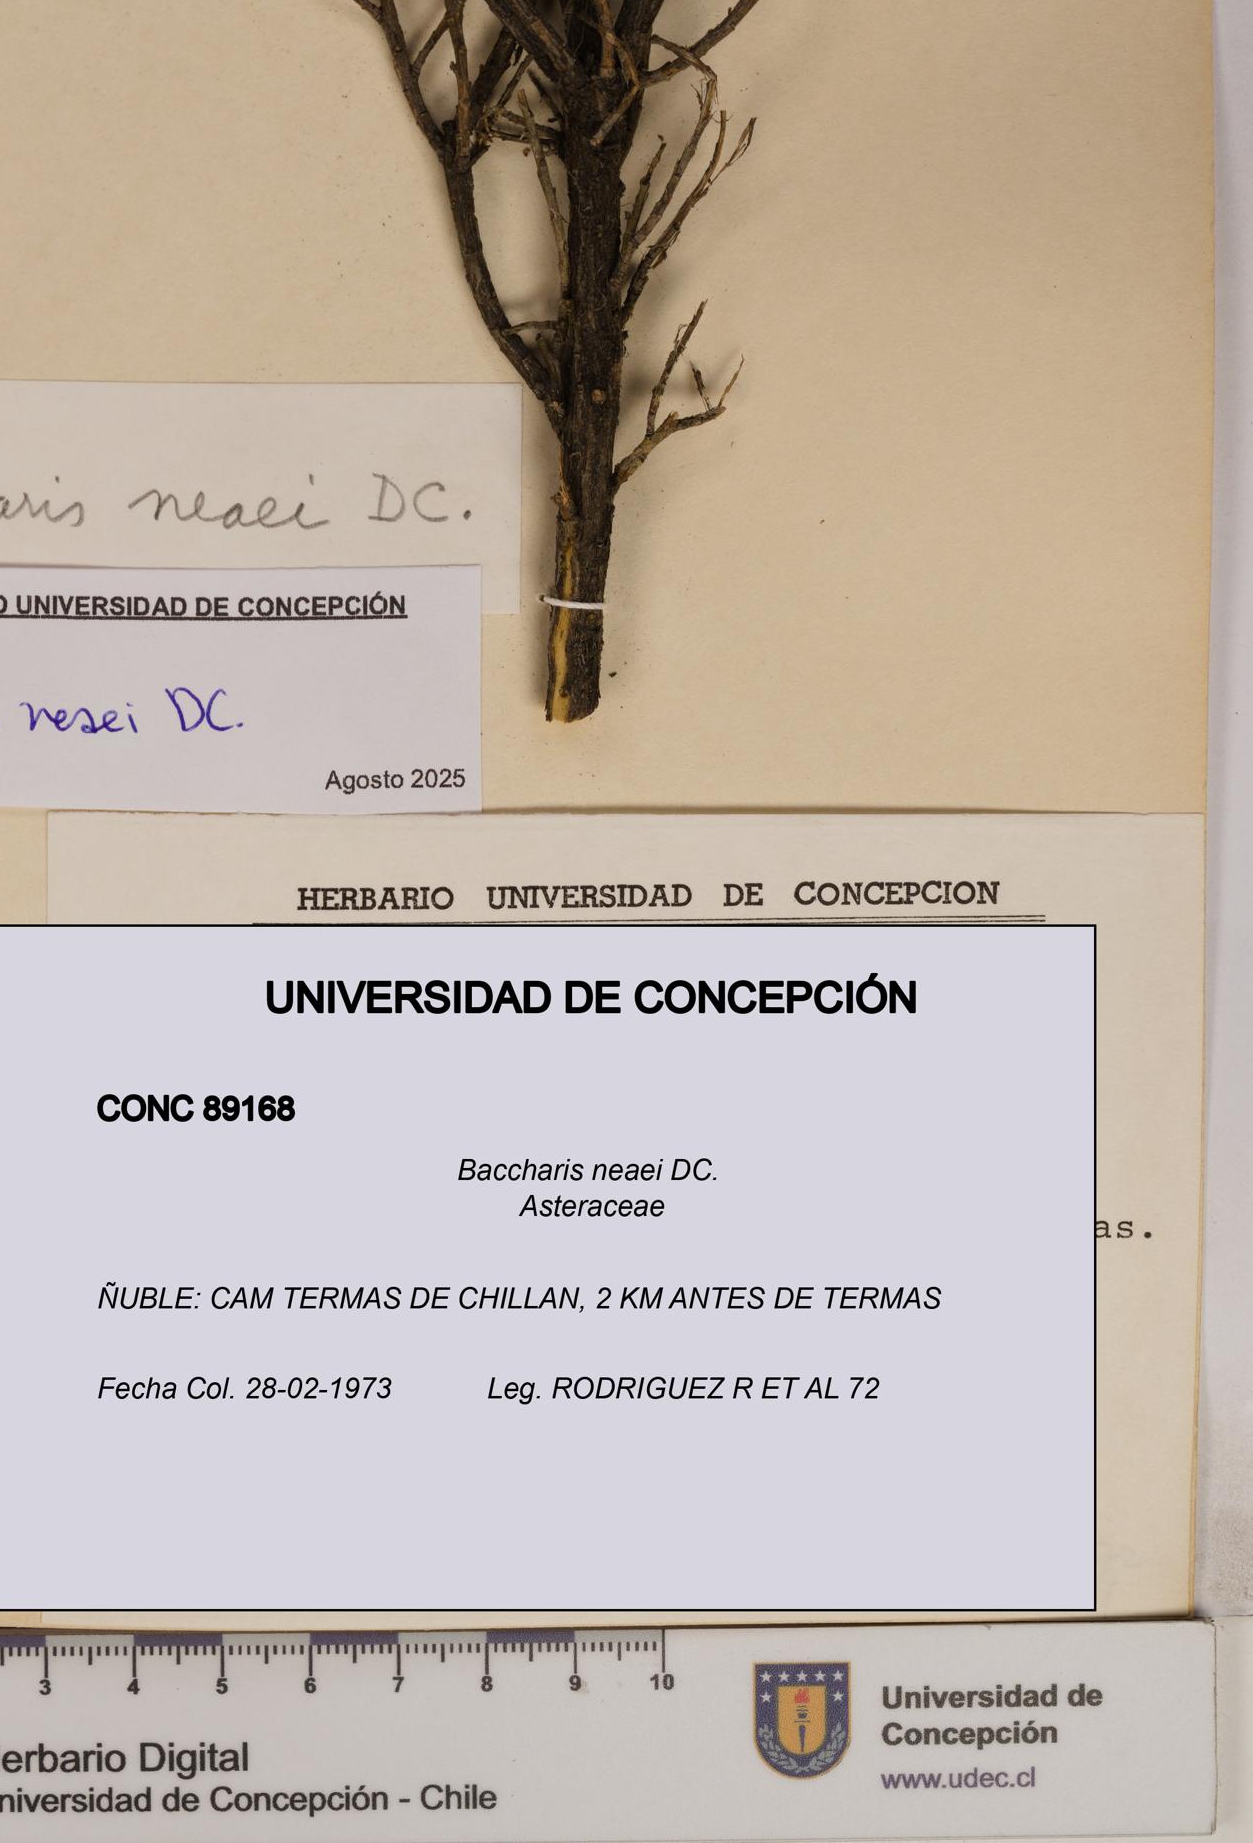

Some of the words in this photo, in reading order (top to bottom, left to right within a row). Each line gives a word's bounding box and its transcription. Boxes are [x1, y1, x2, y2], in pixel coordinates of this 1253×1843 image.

[367, 472, 472, 523] DC.
[16, 595, 186, 618] UNIVERSIDAD
[192, 596, 232, 618] DE
[238, 590, 406, 619] CONCEPCIÓN
[164, 687, 244, 732] DC.
[324, 769, 404, 795] Agosto
[410, 768, 466, 789] 2025
[296, 886, 455, 911] HERBARIO
[486, 883, 693, 910] UNIVERSIDAD
[723, 882, 764, 907] DE
[793, 880, 1001, 907] CONCEPCION
[39, 1678, 52, 1696] 3
[126, 1678, 141, 1695] 4
[215, 1677, 229, 1695] 5
[303, 1676, 317, 1694] 6
[392, 1674, 405, 1693] 7
[480, 1675, 494, 1693] 8
[568, 1674, 582, 1692] 9
[649, 1673, 675, 1691] 10
[882, 1683, 1058, 1710] Universidad
[1066, 1683, 1103, 1708] de
[881, 1720, 1058, 1751] Concepción
[139, 1741, 249, 1781] Digital
[880, 1766, 1036, 1790] www.udec.cl
[161, 1786, 200, 1813] de
[209, 1784, 389, 1818] Concepción
[420, 1783, 498, 1811] Chile
